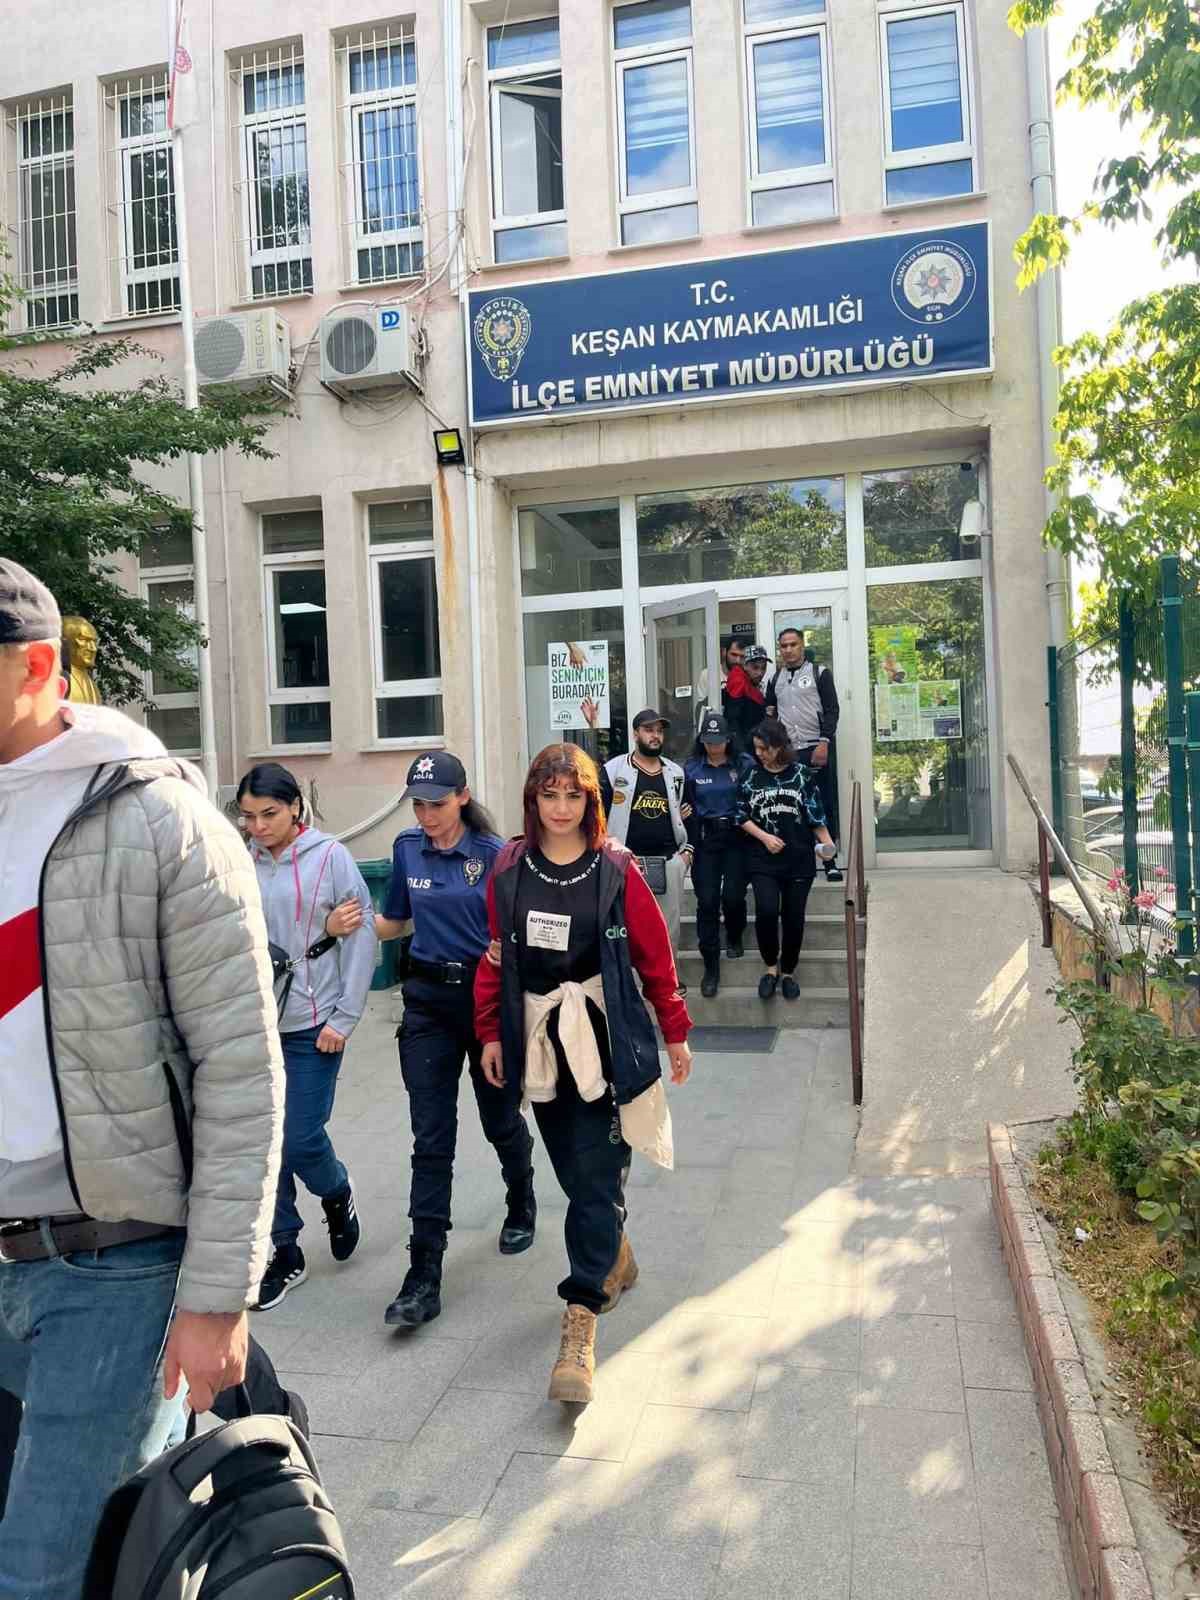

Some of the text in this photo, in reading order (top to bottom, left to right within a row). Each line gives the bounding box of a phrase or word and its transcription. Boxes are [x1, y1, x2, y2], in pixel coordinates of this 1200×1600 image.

[690, 280, 735, 306] T.C.
[572, 324, 656, 357] KEŞAN
[663, 294, 864, 345] KAYMAKAMLIĞI
[512, 333, 935, 412] İLÇE EMNİYET MÜDÜRLÜĞÜ
[552, 683, 606, 700] BURADAYIZ
[529, 916, 568, 928] AUTHORIZED
